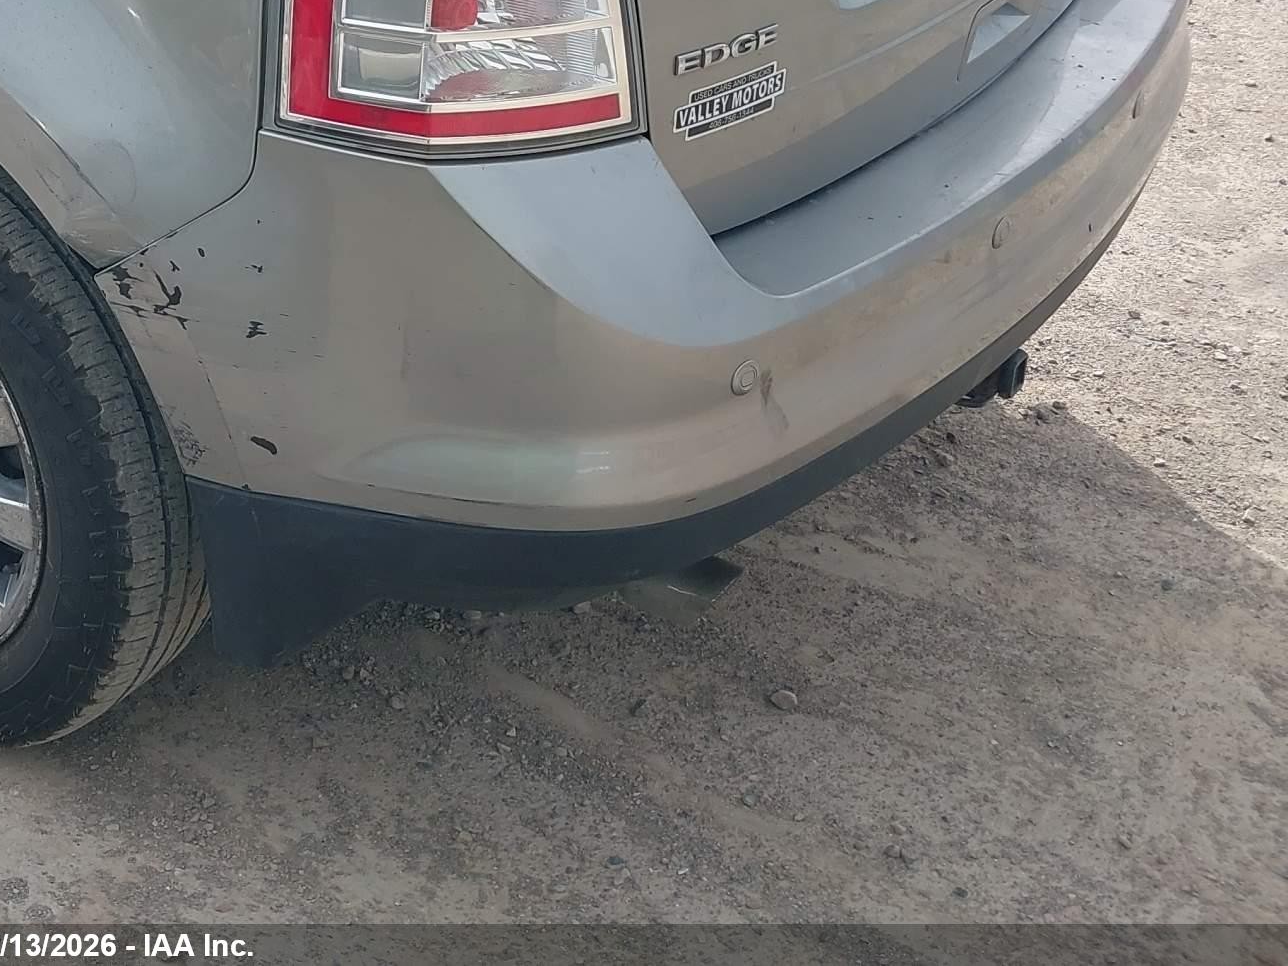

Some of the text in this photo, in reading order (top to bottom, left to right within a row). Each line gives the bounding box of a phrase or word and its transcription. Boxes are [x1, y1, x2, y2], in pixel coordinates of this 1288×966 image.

[673, 23, 779, 76] EDGE
[679, 74, 782, 127] VALLEY MOTORS
[694, 89, 713, 101] USED
[714, 82, 732, 95] CARS
[732, 77, 747, 88] AND
